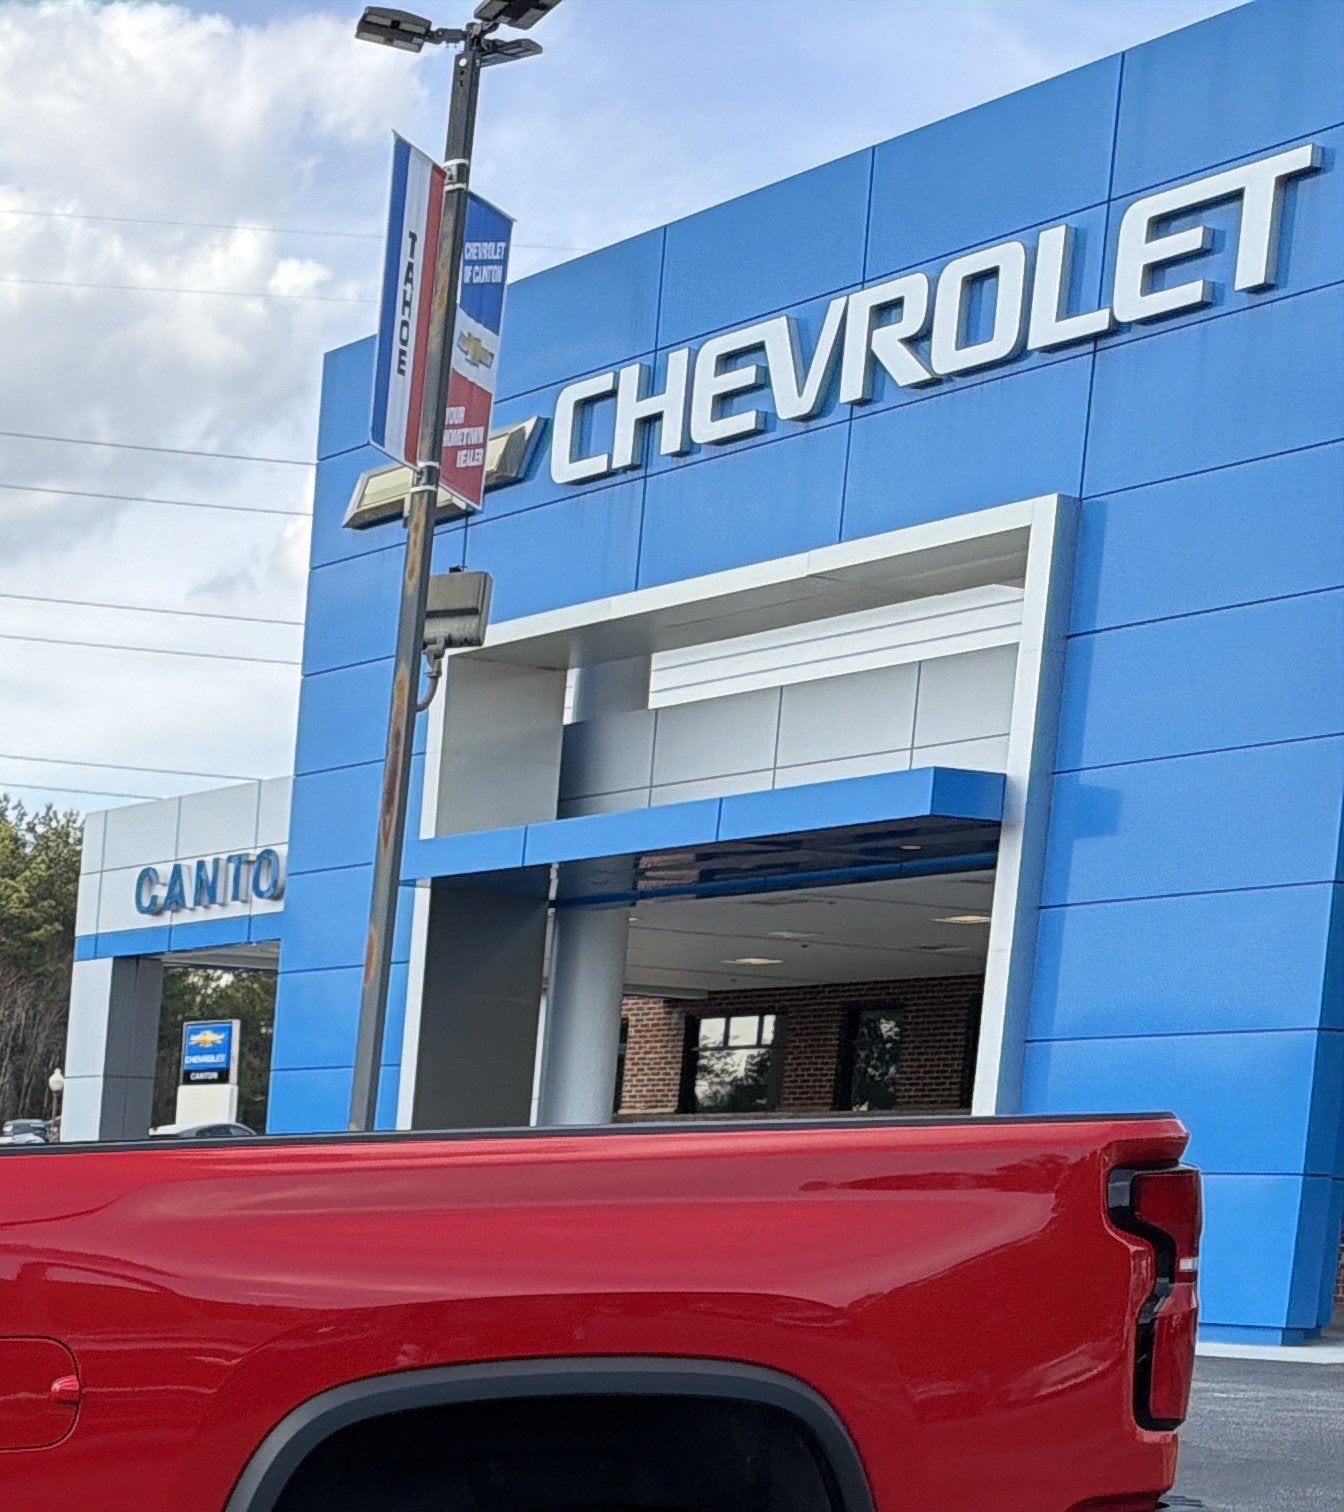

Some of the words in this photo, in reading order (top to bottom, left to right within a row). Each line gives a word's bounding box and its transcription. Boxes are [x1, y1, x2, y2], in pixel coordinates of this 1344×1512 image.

[396, 230, 418, 377] TAHOE
[551, 143, 1322, 485] CHEVROLET
[134, 848, 284, 915] CANTO
